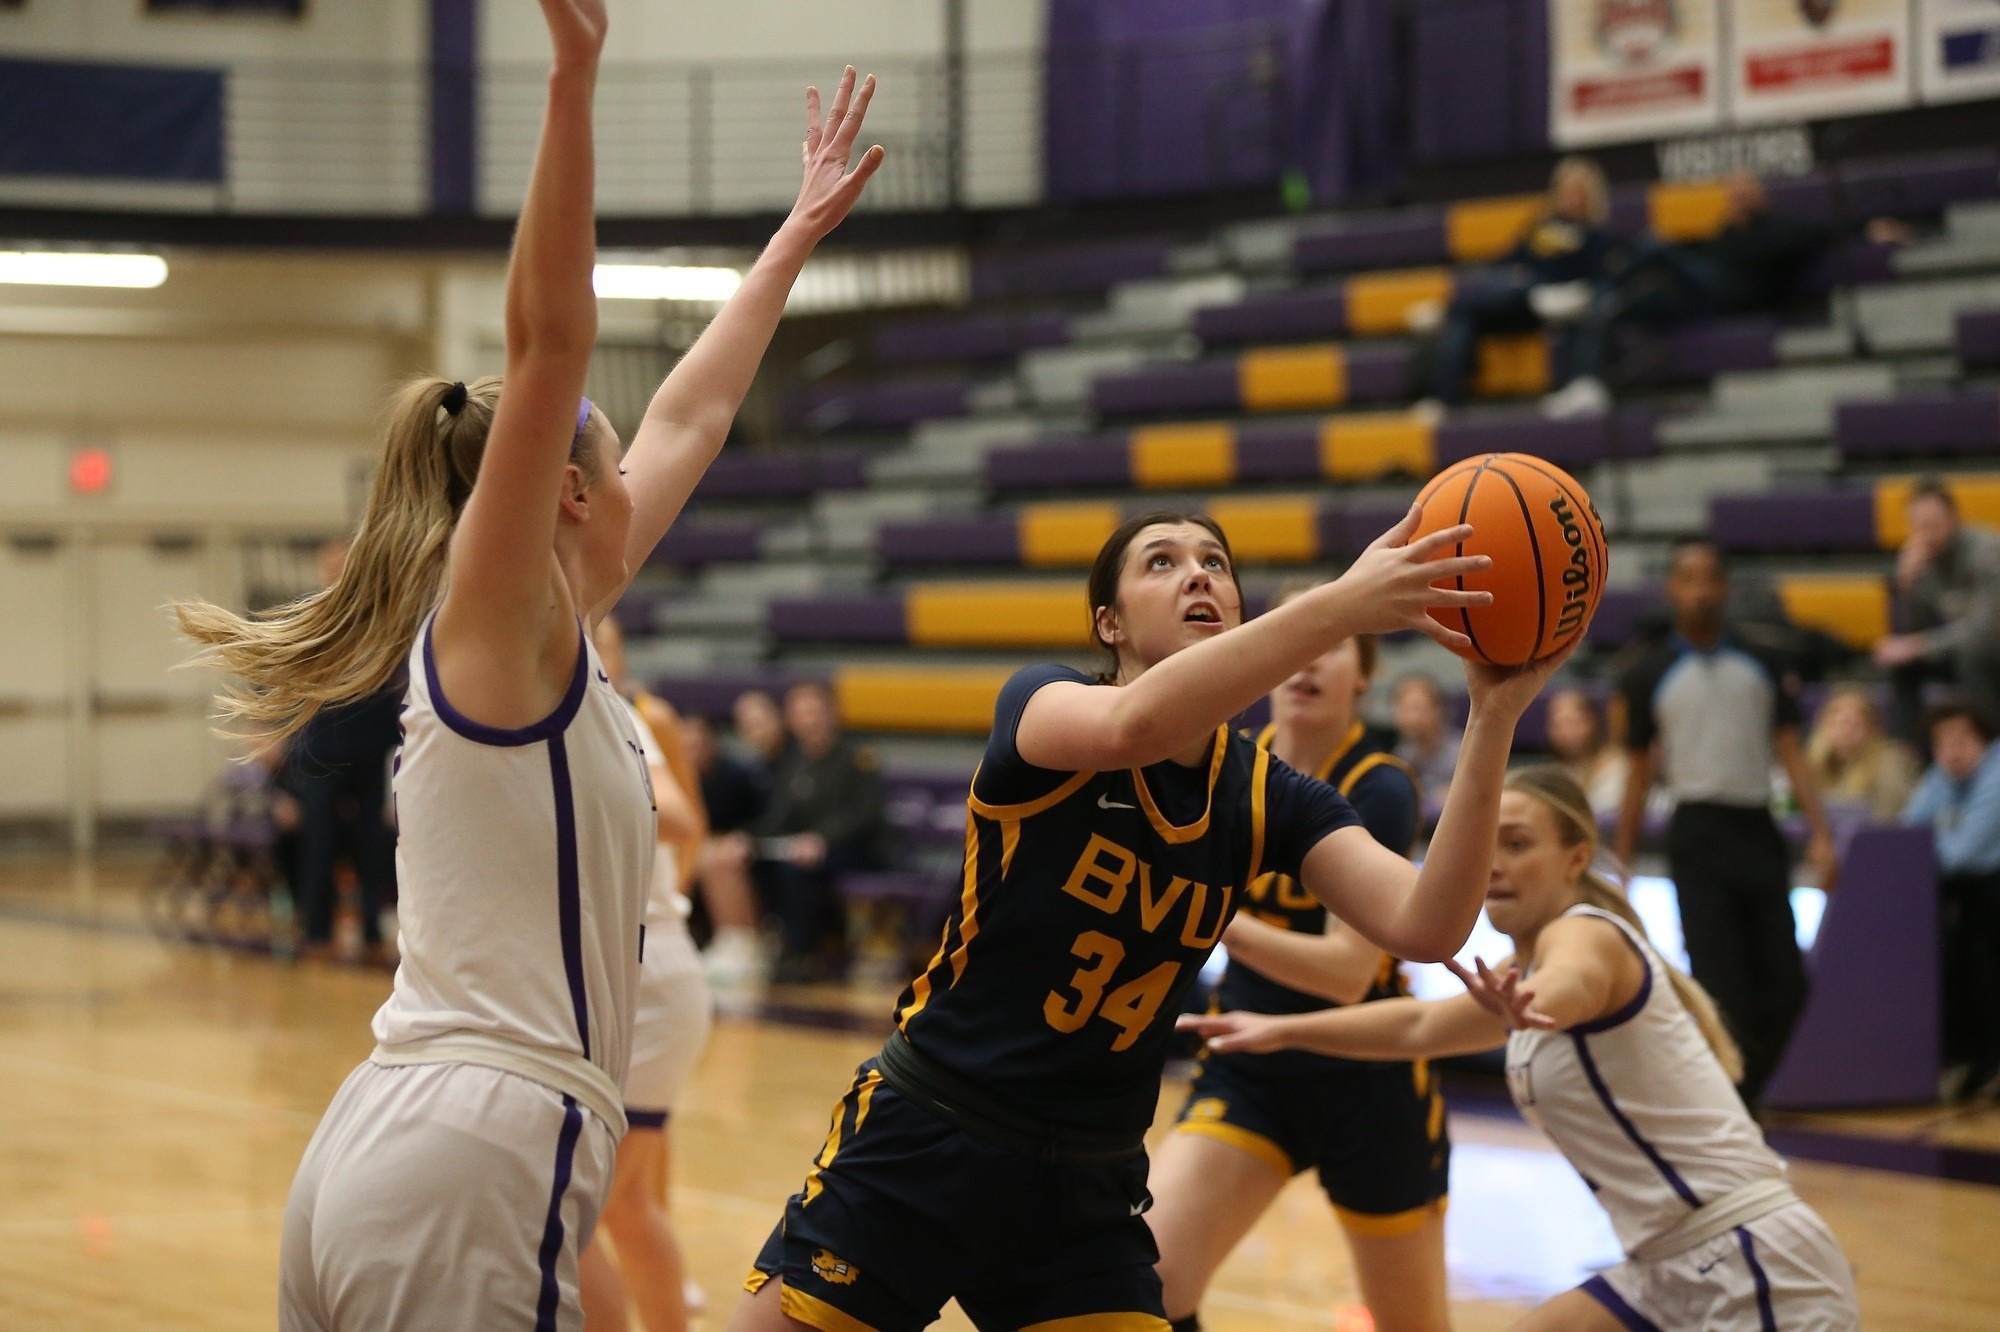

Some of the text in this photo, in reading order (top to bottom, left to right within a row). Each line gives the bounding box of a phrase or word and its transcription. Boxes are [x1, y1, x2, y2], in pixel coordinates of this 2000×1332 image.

[1550, 494, 1590, 640] Wilson
[1061, 832, 1232, 950] BVU
[1043, 930, 1182, 1052] 34
